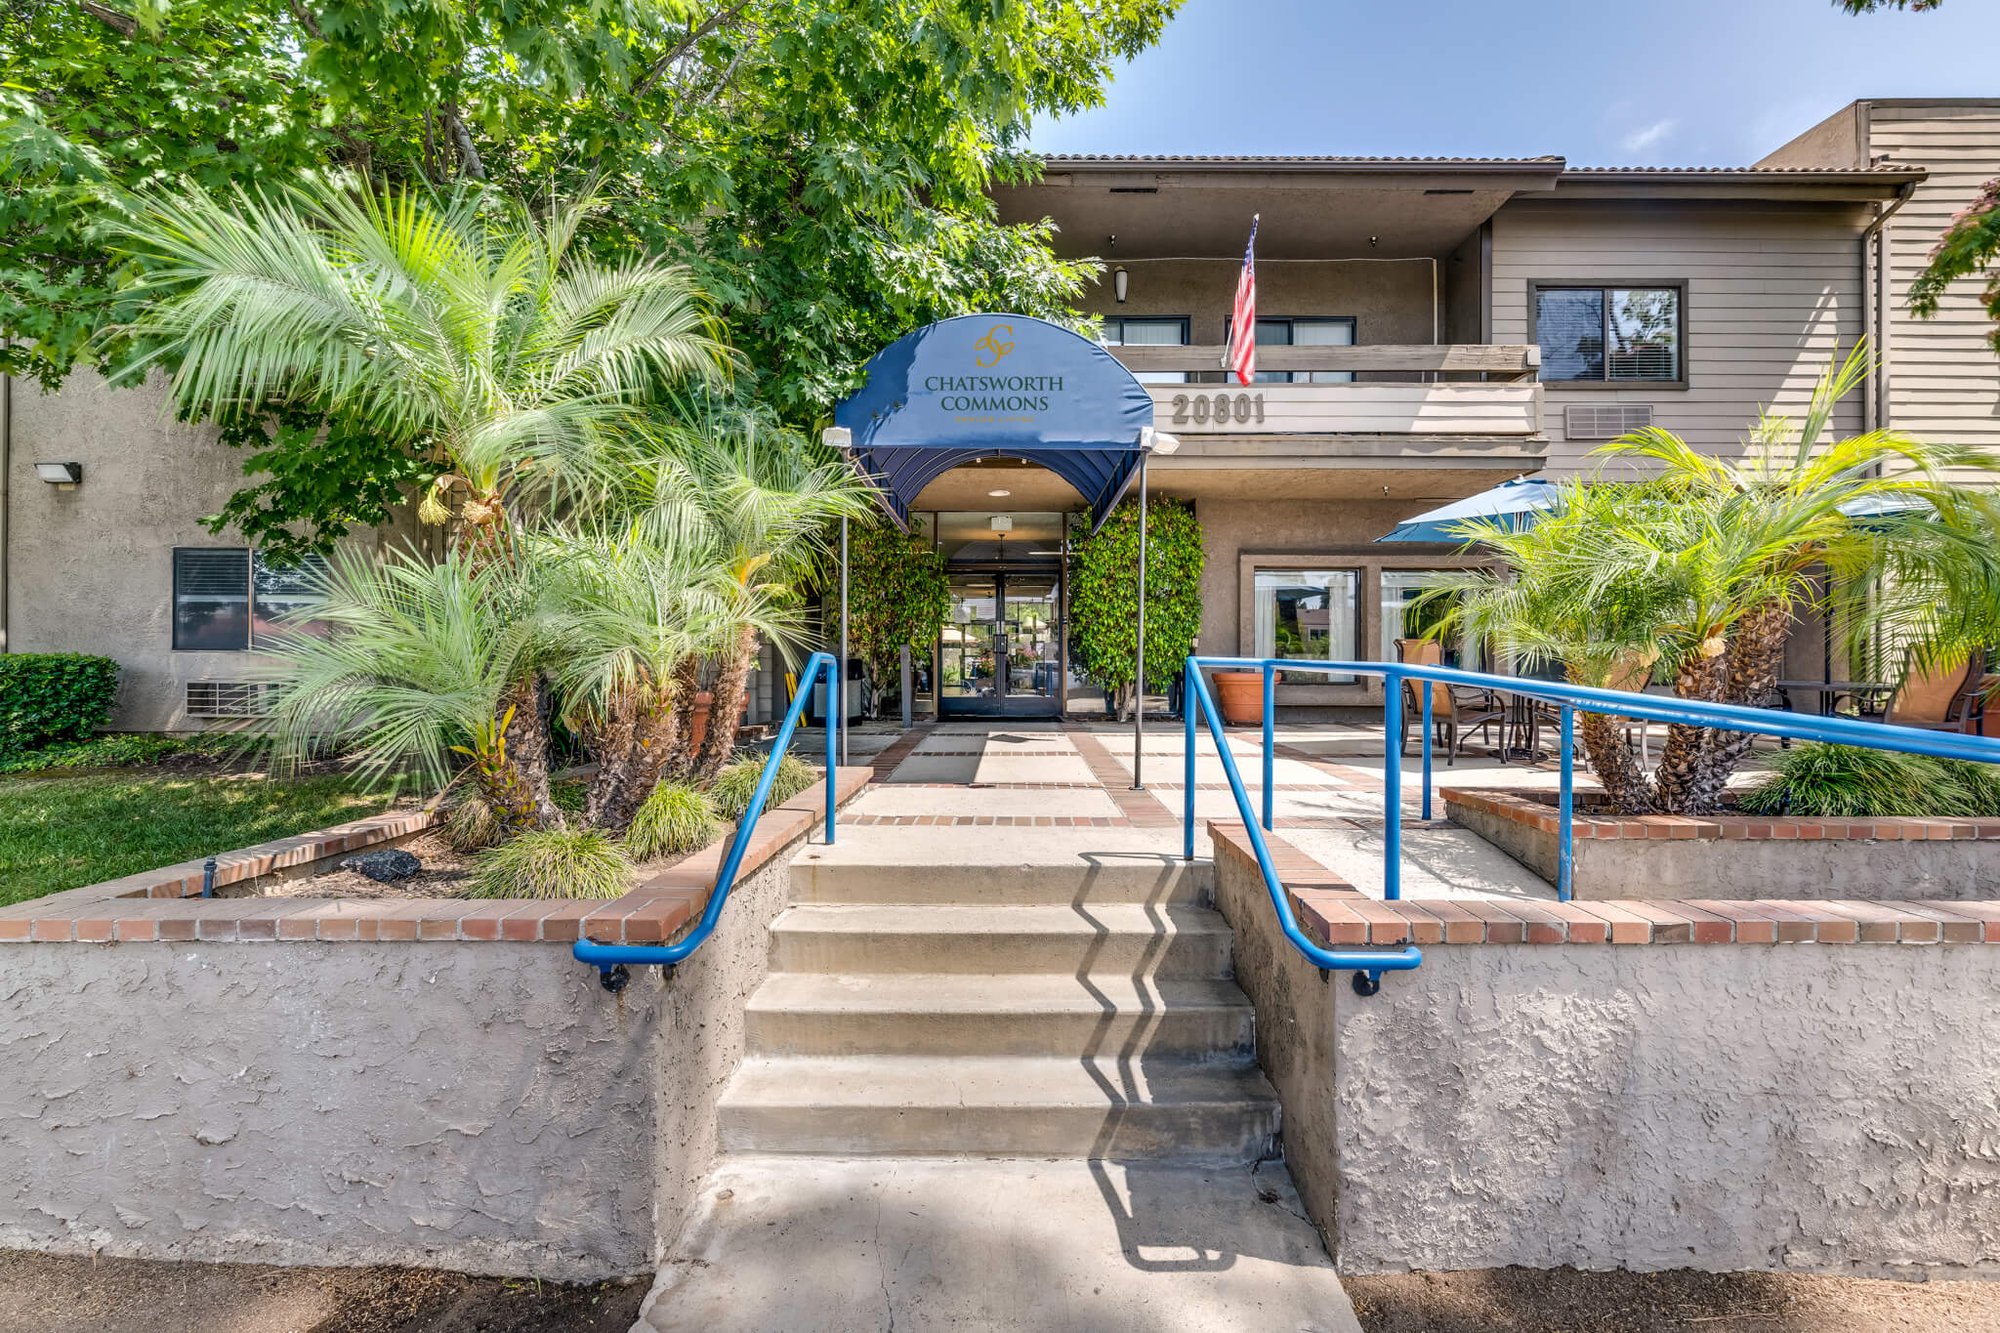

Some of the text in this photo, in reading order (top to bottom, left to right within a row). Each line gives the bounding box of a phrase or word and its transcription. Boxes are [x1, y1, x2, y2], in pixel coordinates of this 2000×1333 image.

[924, 376, 1064, 392] CHATSWORTH
[940, 396, 1049, 412] COMMONS
[1172, 393, 1265, 424] 20801
